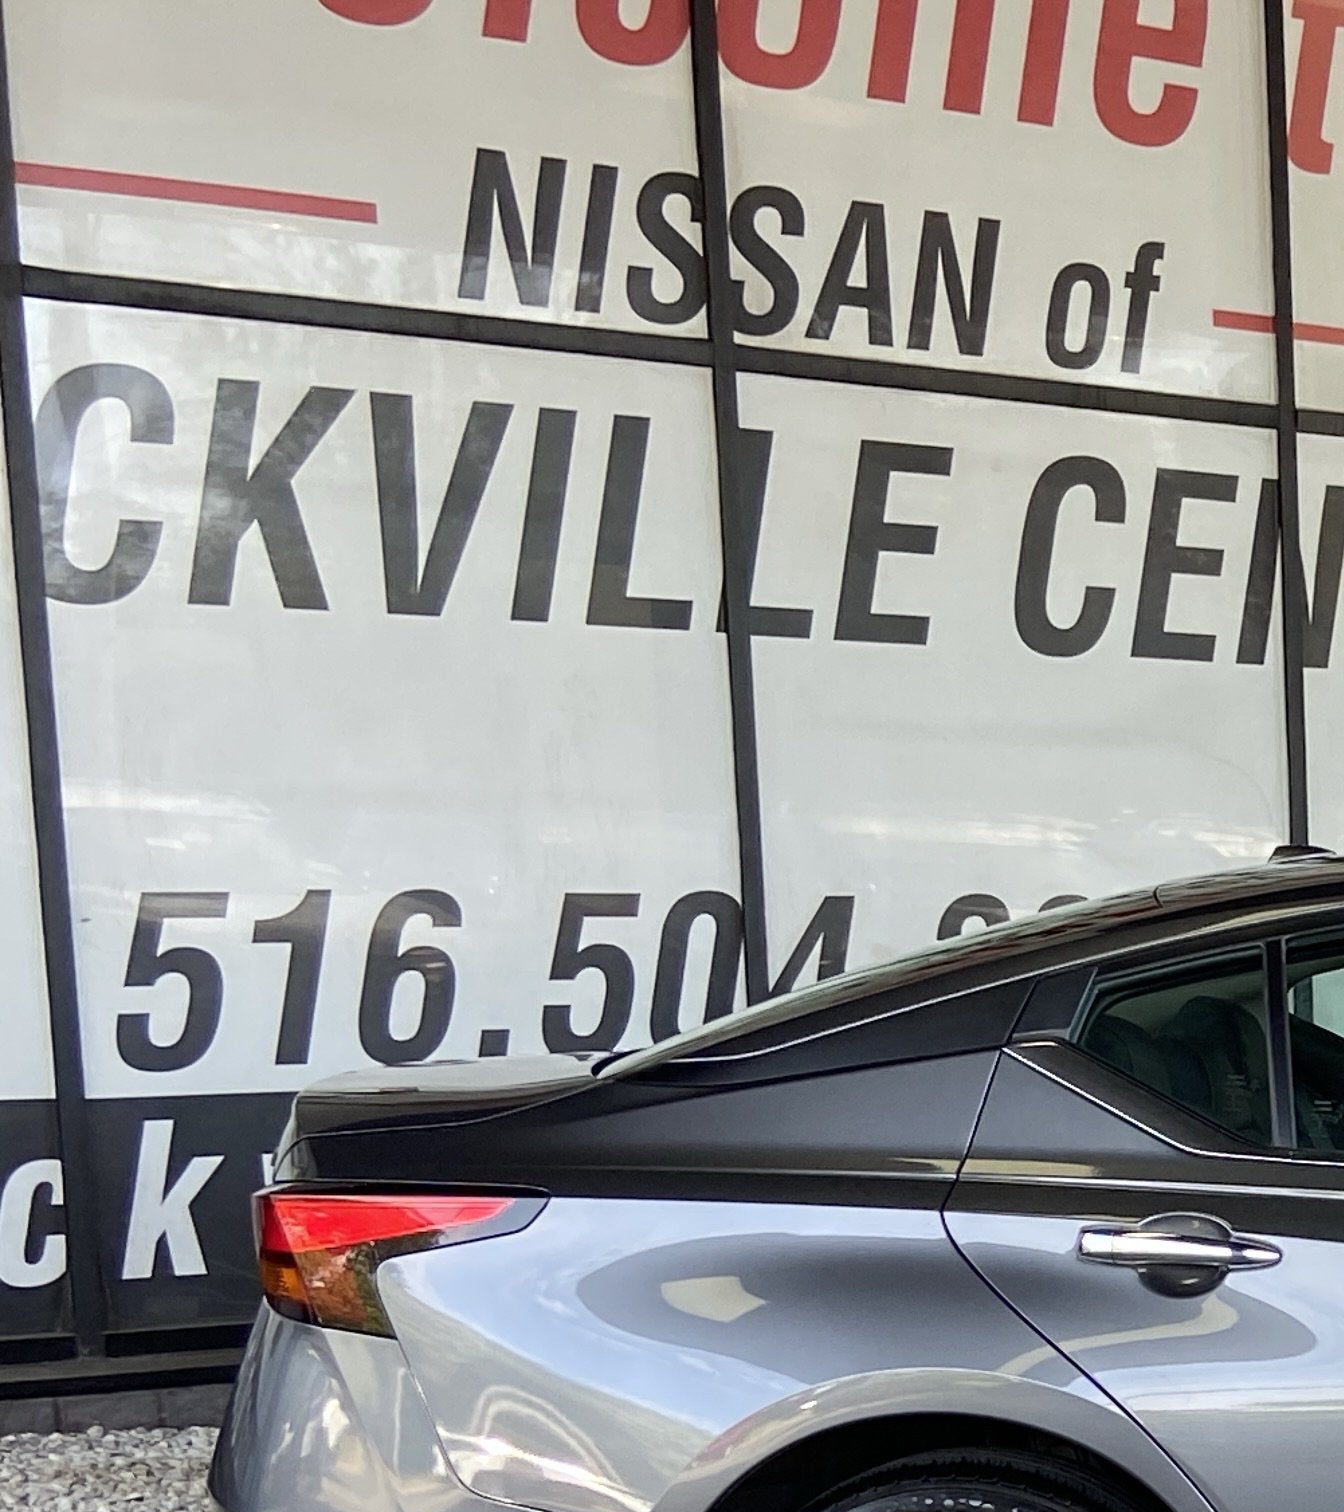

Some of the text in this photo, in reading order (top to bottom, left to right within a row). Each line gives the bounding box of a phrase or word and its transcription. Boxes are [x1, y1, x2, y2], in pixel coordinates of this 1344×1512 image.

[457, 147, 1166, 374] NISSAN of
[35, 362, 954, 646] CKVILLE
[117, 890, 1092, 1073] 516.504
[0, 1119, 274, 1288] ck
